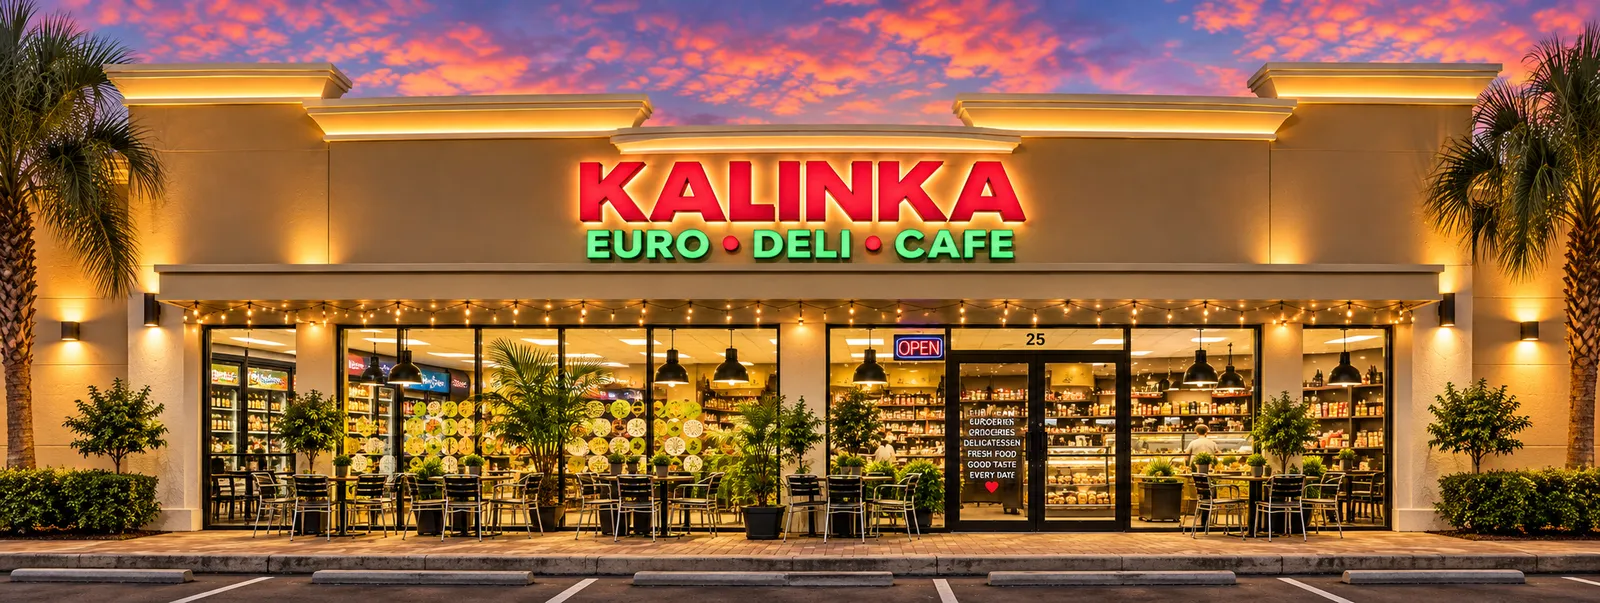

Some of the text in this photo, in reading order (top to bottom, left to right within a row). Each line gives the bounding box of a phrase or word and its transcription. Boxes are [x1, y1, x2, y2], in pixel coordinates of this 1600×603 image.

[579, 160, 1026, 223] KALINKA
[586, 229, 1015, 261] EURO DELI CAFE
[1026, 332, 1046, 346] 25
[898, 340, 940, 356] OPEN
[963, 439, 1021, 447] DELICATESSEN
[967, 450, 1017, 458] FRESH FOOD
[969, 471, 995, 479] EVERY
